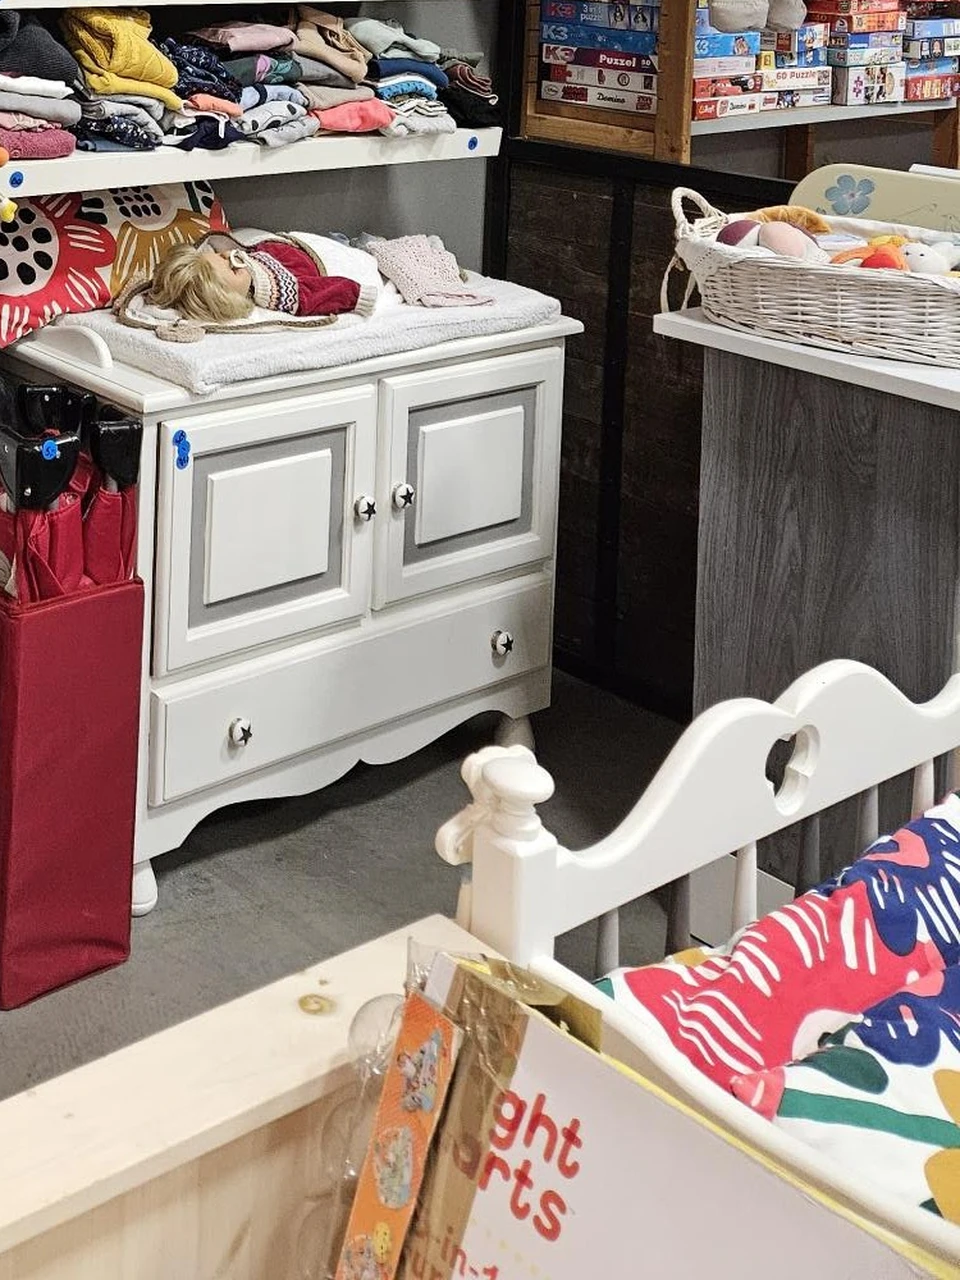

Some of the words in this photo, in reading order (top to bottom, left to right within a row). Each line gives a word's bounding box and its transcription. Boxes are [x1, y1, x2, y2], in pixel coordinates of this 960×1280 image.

[542, 24, 568, 41] K3
[544, 46, 576, 61] K3
[599, 54, 637, 67] Puzzel
[790, 71, 817, 80] Puzzle
[596, 92, 626, 104] Domino
